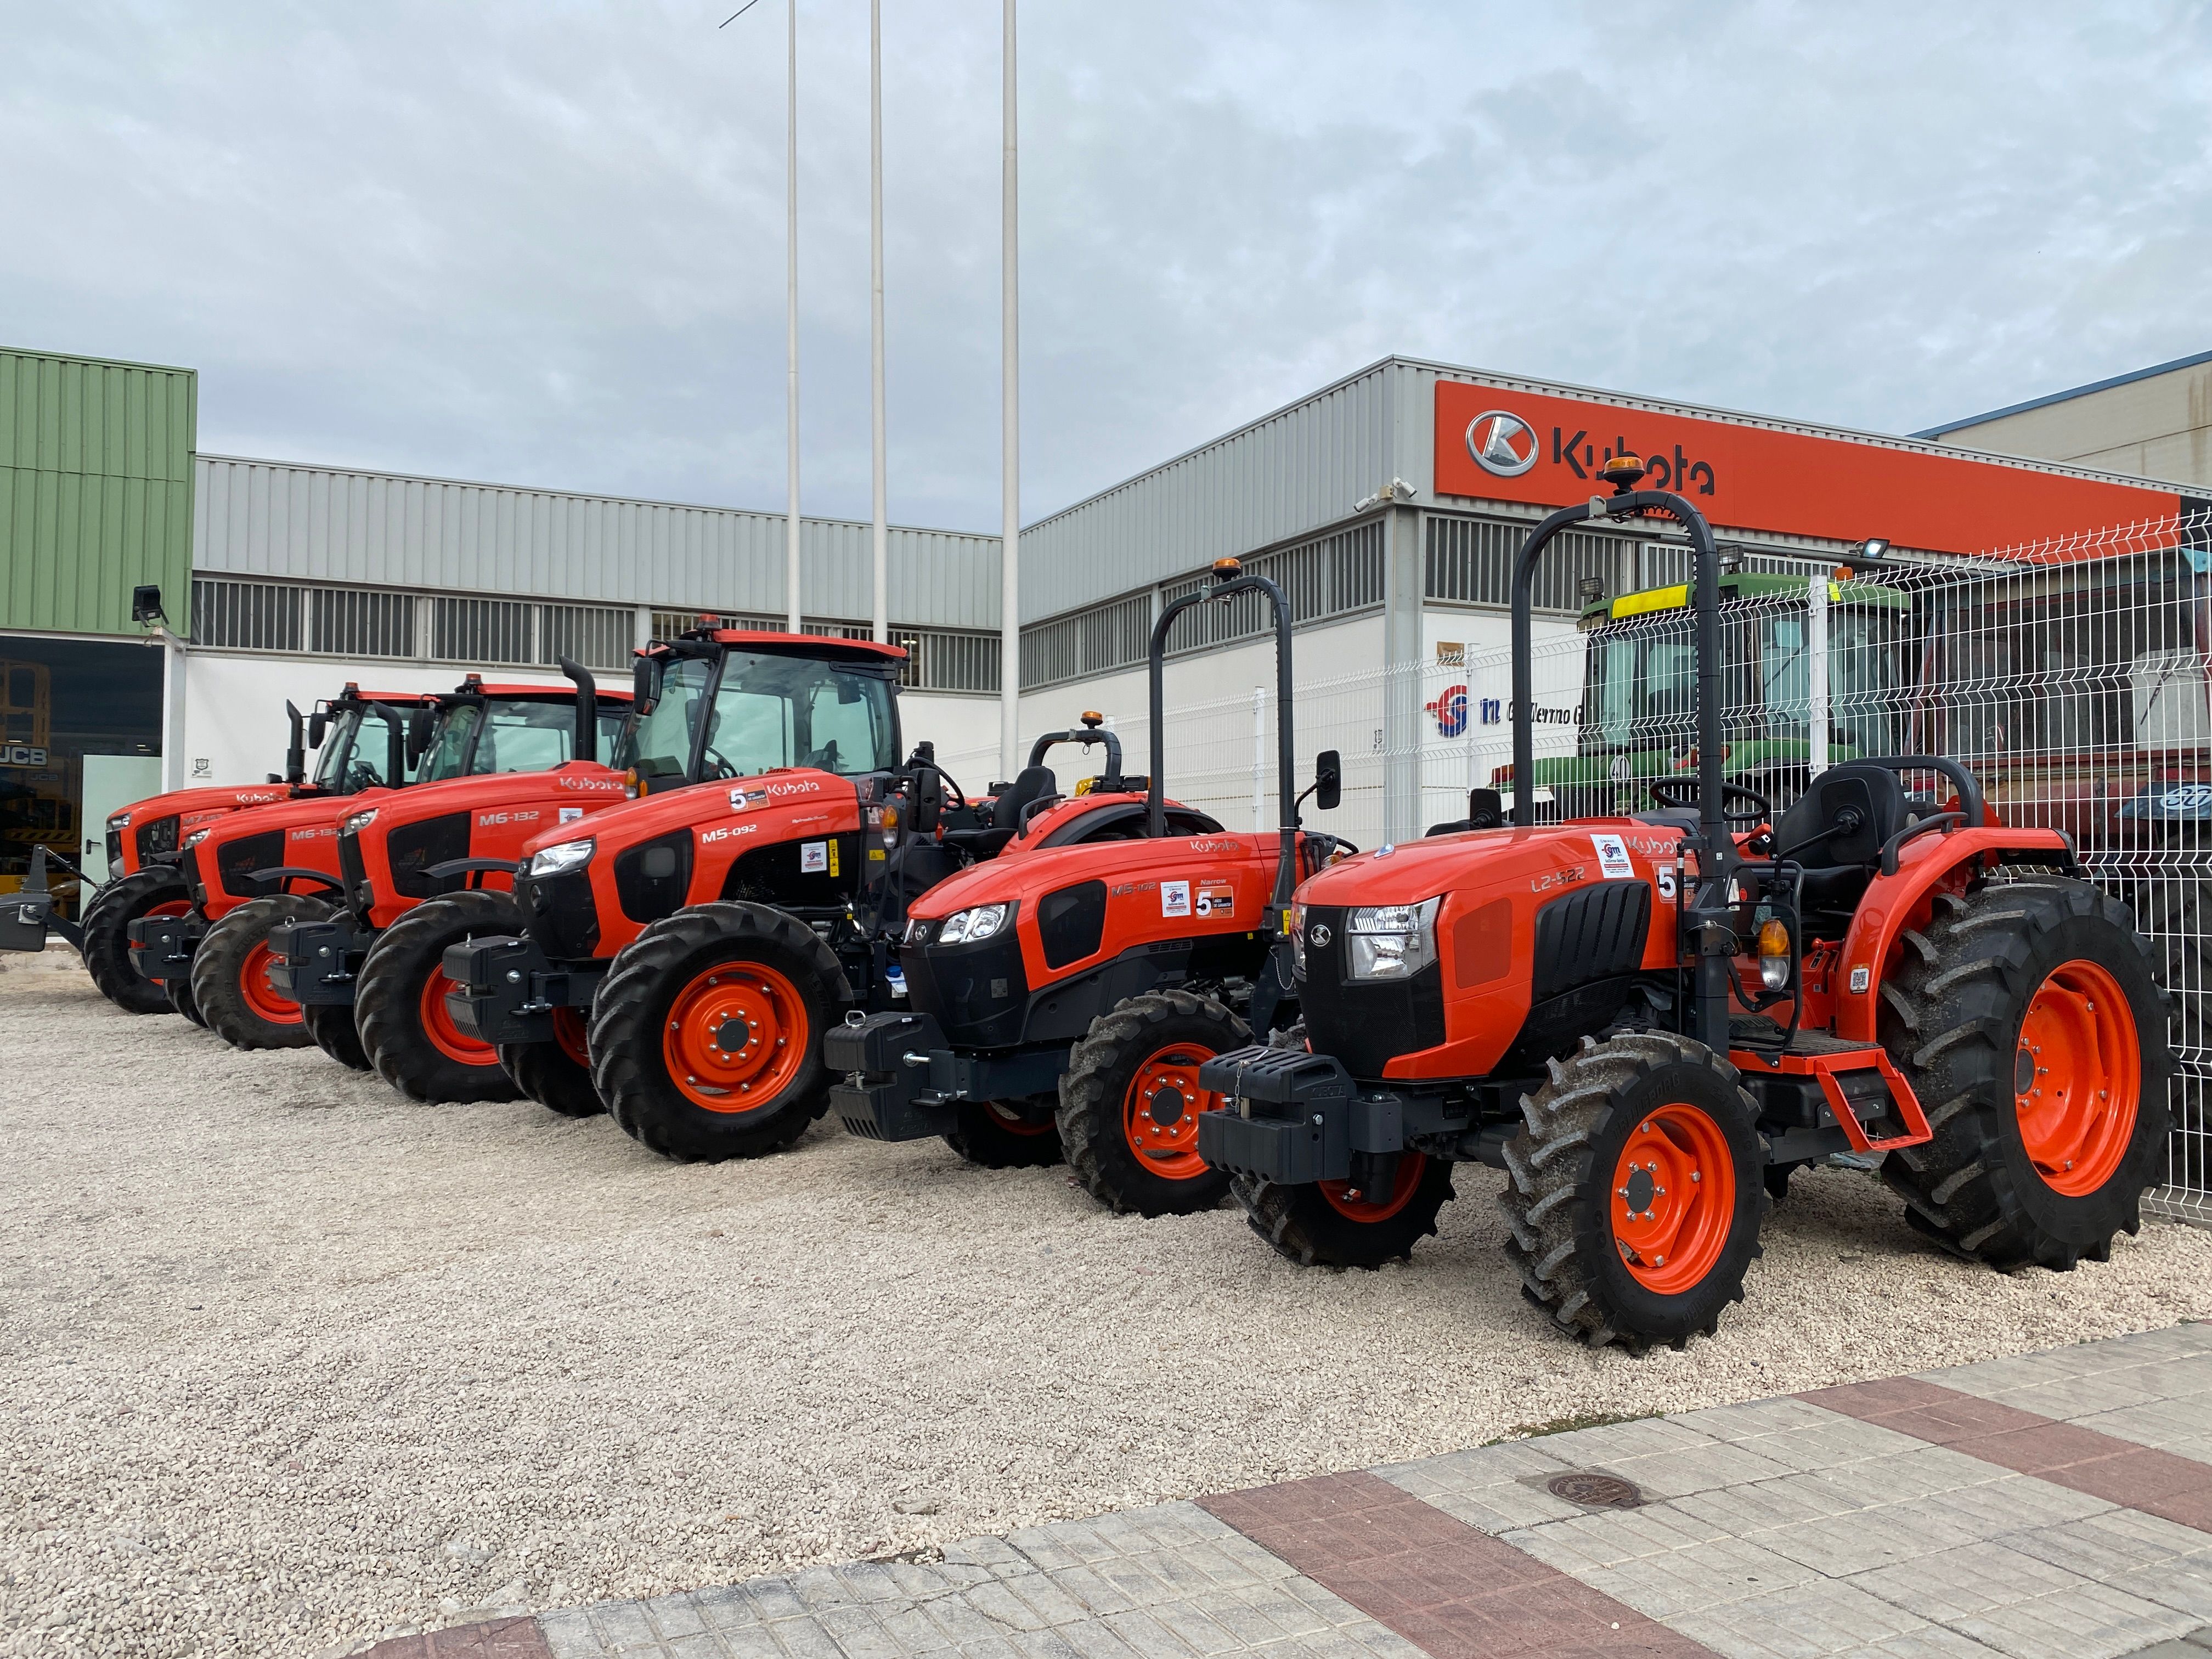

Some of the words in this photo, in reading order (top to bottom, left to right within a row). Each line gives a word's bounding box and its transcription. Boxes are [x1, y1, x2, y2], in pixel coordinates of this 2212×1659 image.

[0, 746, 47, 765] JCB
[1612, 758, 1627, 782] 40
[560, 777, 623, 790] Kubota
[767, 780, 820, 795] Kubota
[730, 788, 747, 809] 5
[479, 811, 539, 827] M6-132
[702, 824, 757, 844] M5-092
[1189, 840, 1239, 852] Kubota
[1625, 836, 1692, 855] Kubot
[1530, 865, 1587, 894] L2-522
[1658, 866, 1676, 898] 5
[1111, 882, 1156, 898] M5-102
[1196, 891, 1212, 916] 5
